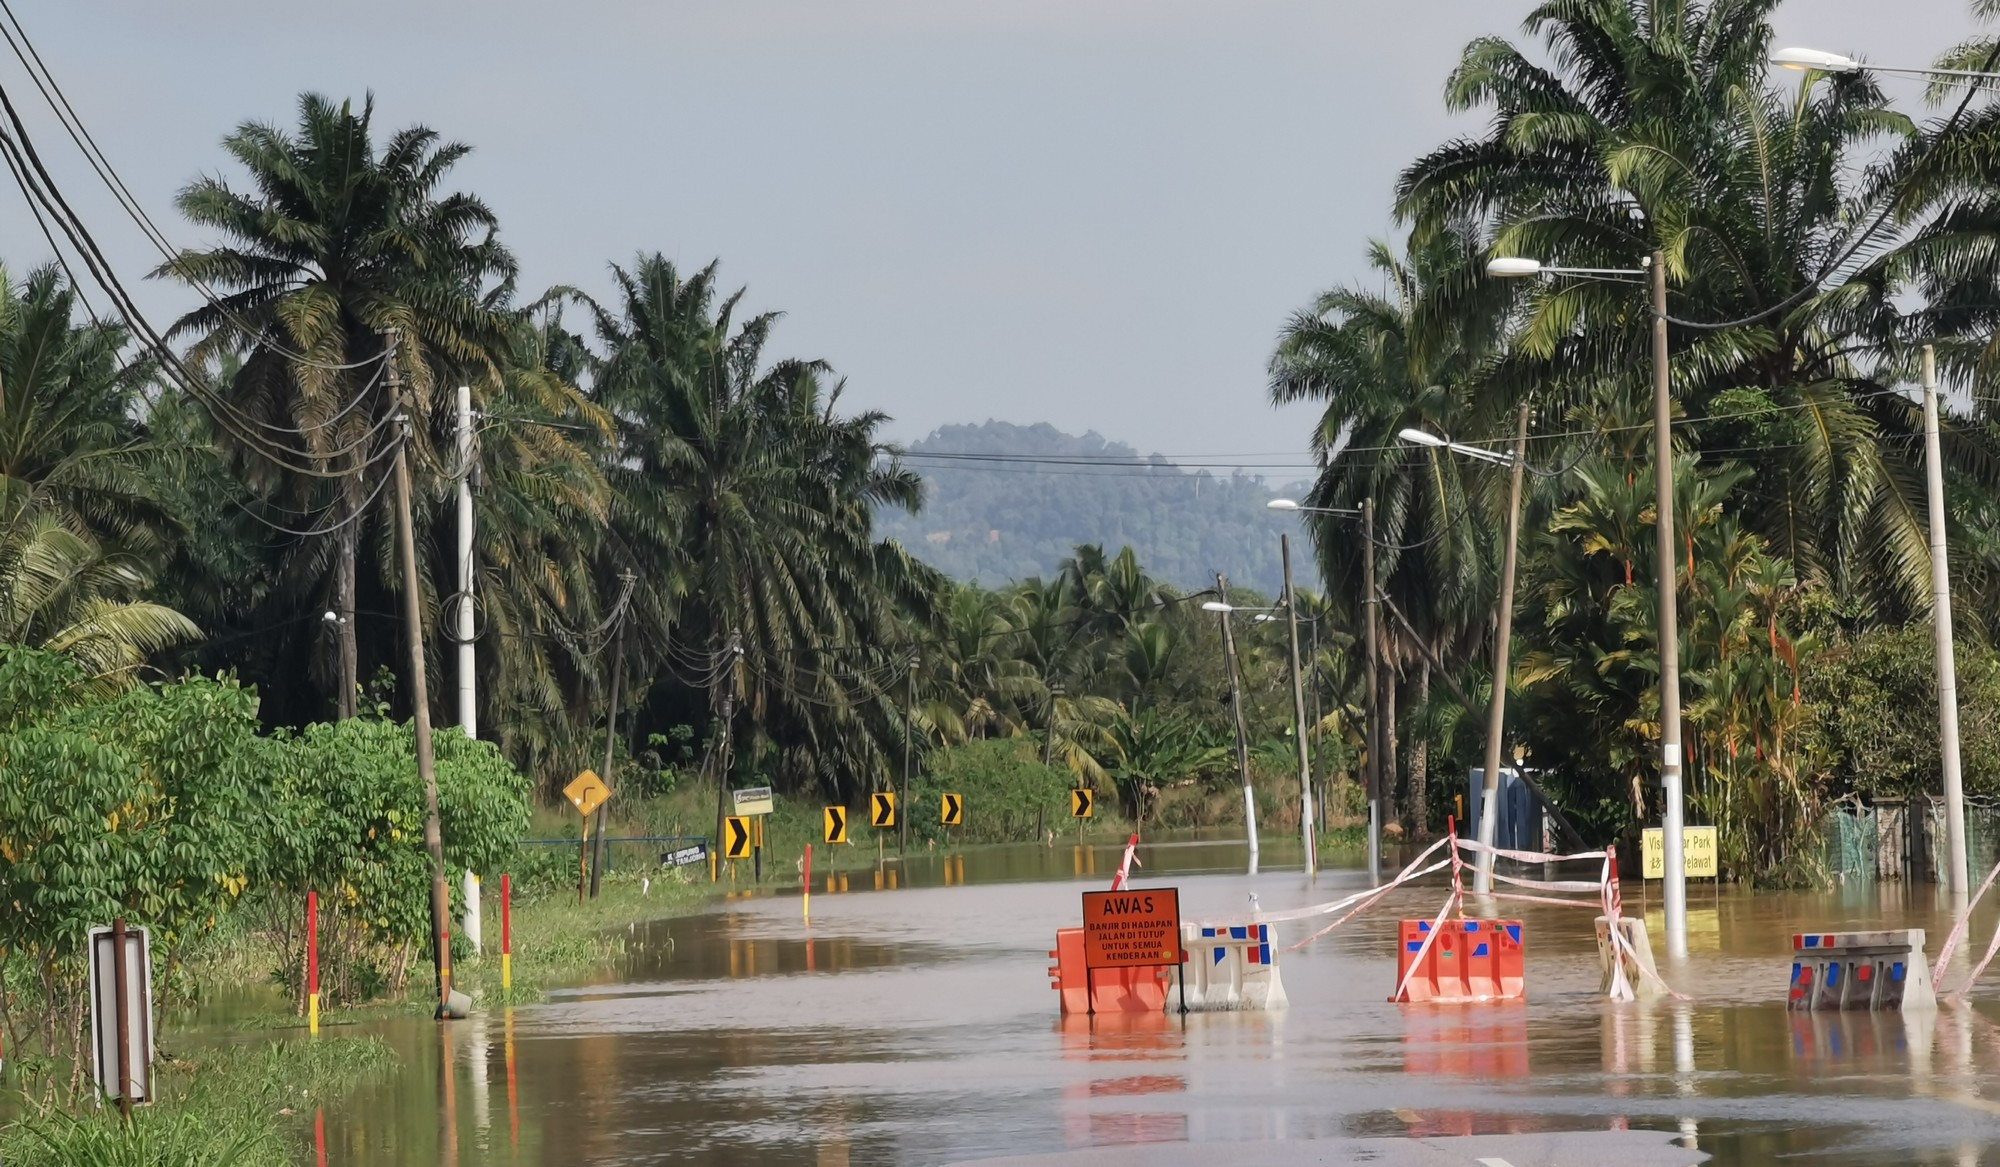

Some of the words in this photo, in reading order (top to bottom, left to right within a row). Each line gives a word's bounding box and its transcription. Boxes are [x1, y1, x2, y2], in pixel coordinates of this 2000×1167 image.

[1649, 836, 1663, 851] Visi
[1682, 838, 1690, 849] ar
[1693, 835, 1711, 849] Park
[1103, 896, 1154, 916] AWAS
[1089, 922, 1119, 931] BANJIR
[1121, 921, 1130, 930] DI
[1131, 920, 1173, 929] HADAPAN
[1098, 932, 1125, 941] JALAN
[1127, 931, 1136, 939] DI
[1138, 930, 1165, 939] TUTUP
[1102, 942, 1130, 951] UNTUK
[1132, 940, 1163, 949] SEMUA
[1106, 951, 1160, 961] KENDERAAN
